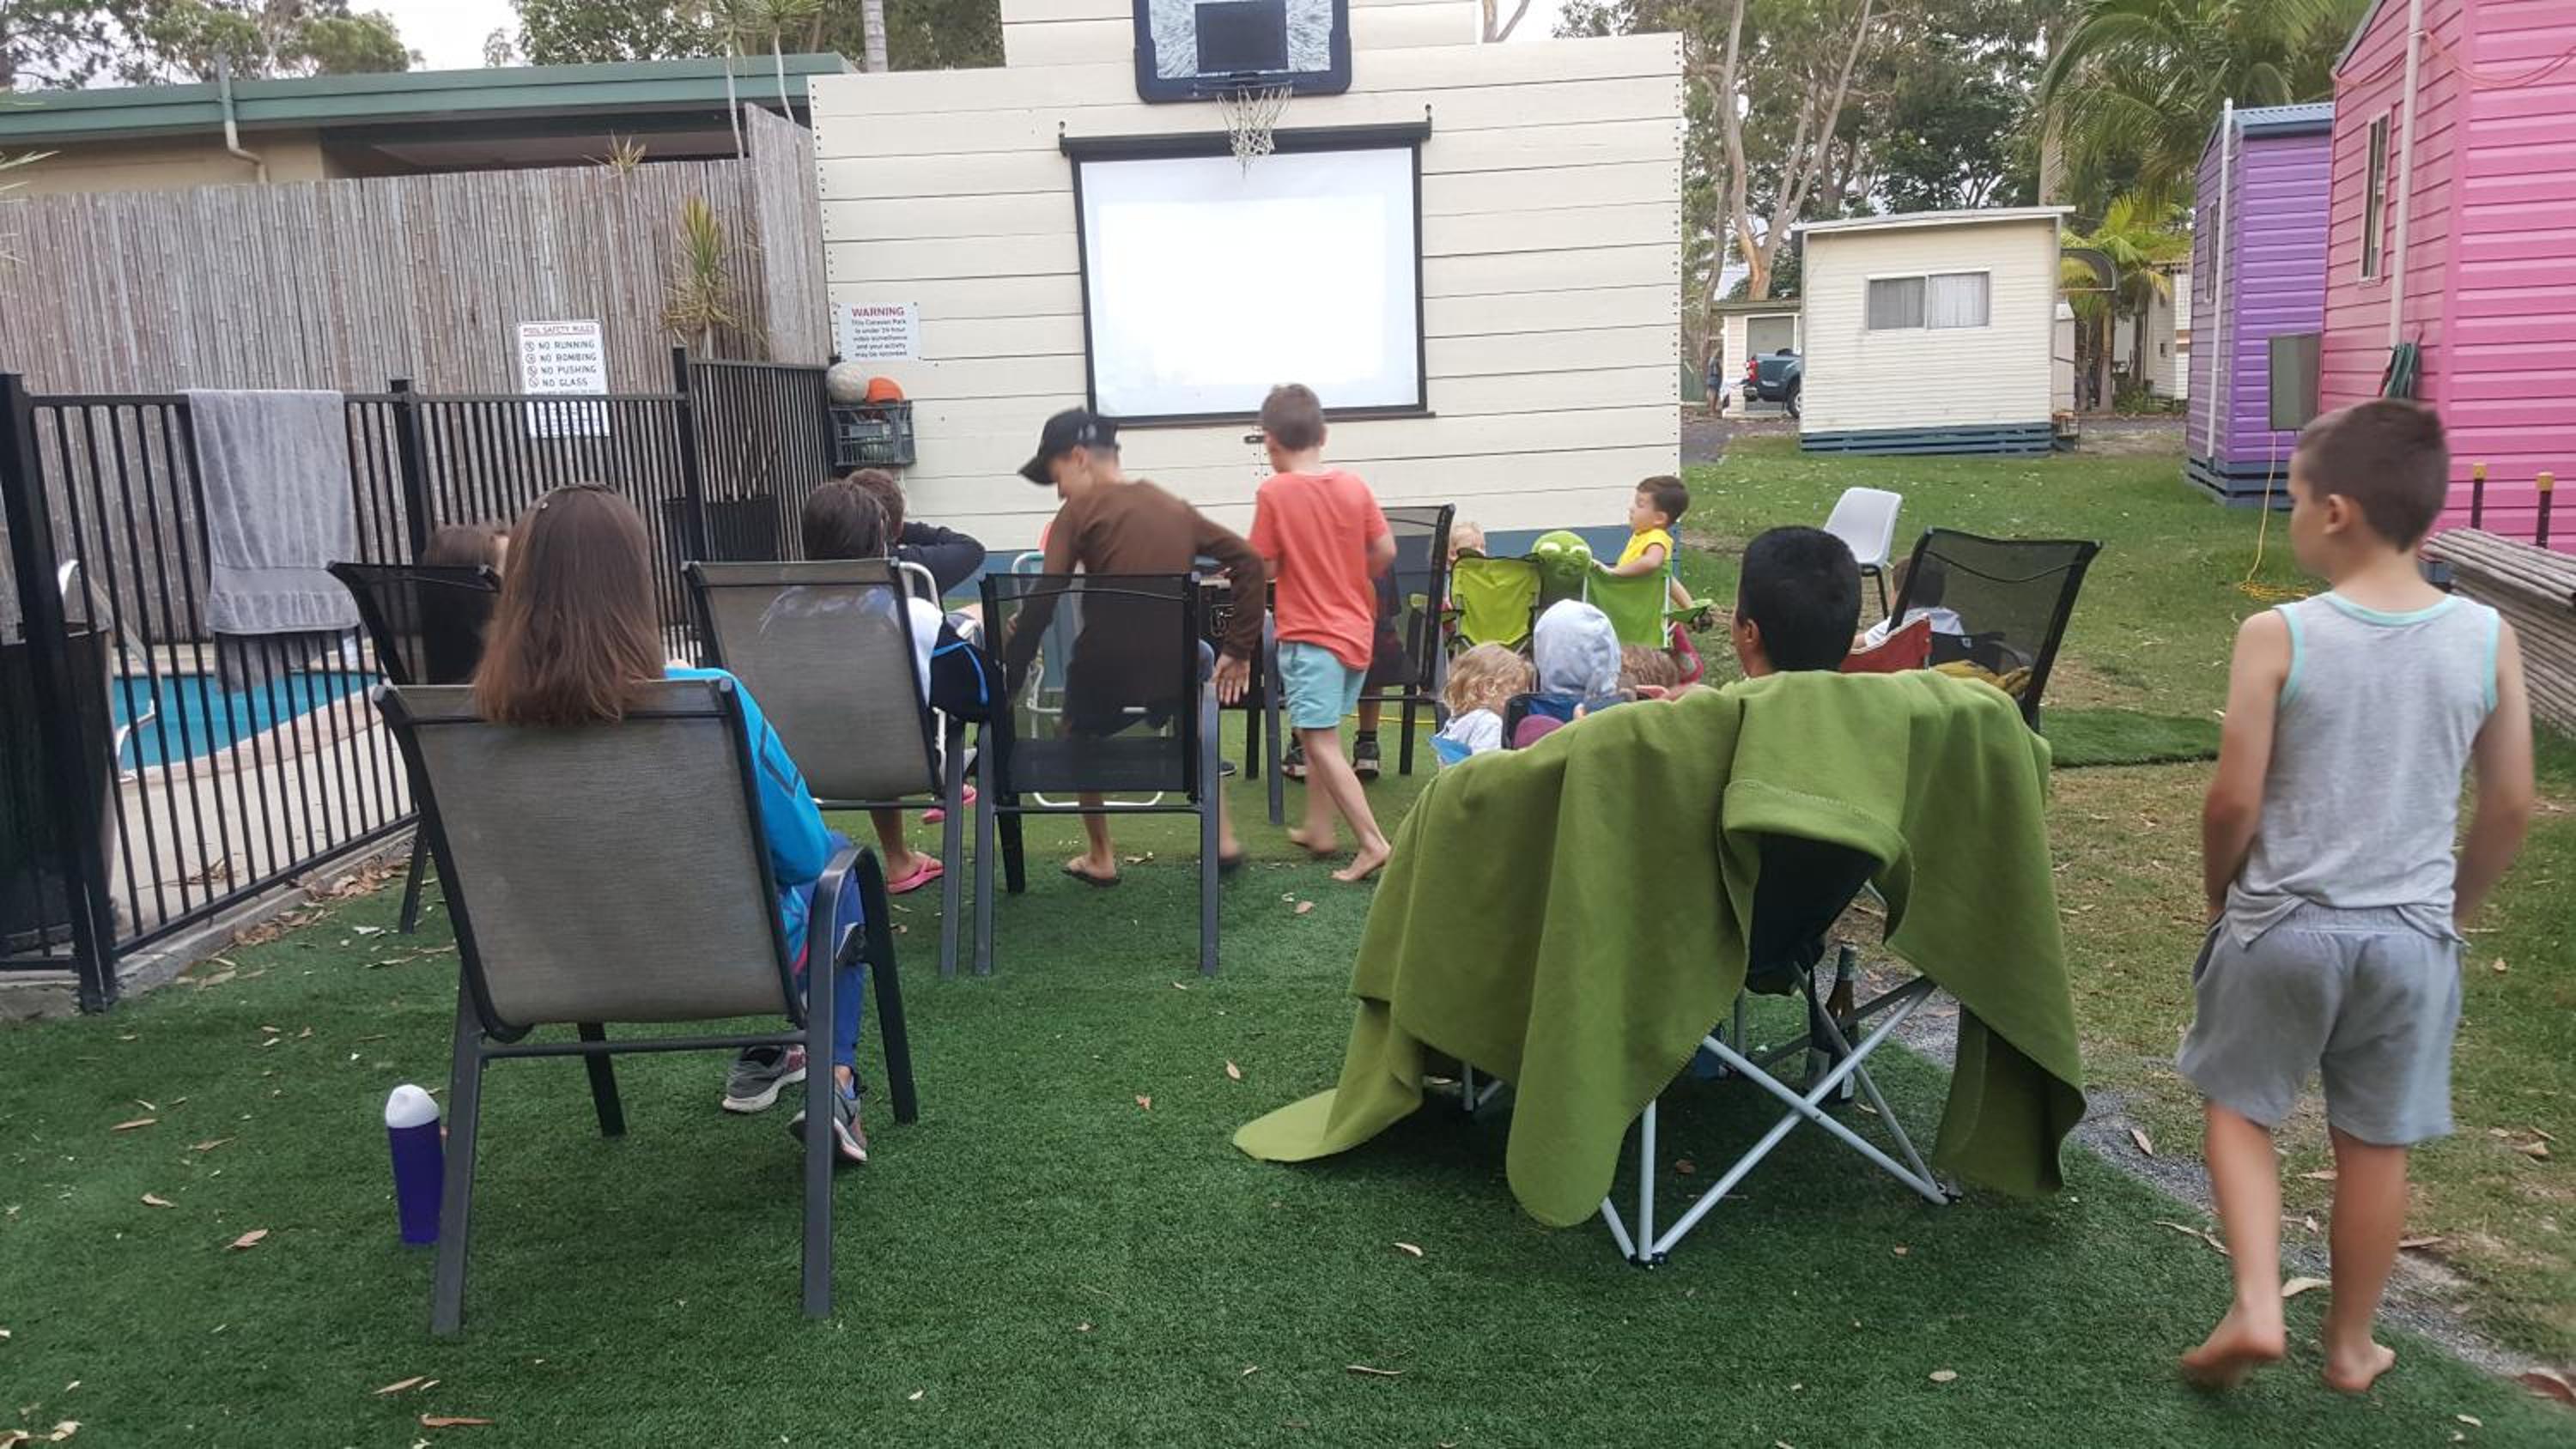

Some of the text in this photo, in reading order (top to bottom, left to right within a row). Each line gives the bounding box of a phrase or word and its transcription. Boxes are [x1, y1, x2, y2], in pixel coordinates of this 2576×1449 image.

[852, 306, 904, 317] WARNING
[538, 341, 595, 350] NO RUNNING
[556, 353, 597, 361] BOMBING
[541, 365, 597, 375] NO PUSHING
[542, 378, 588, 387] NO GLASS
